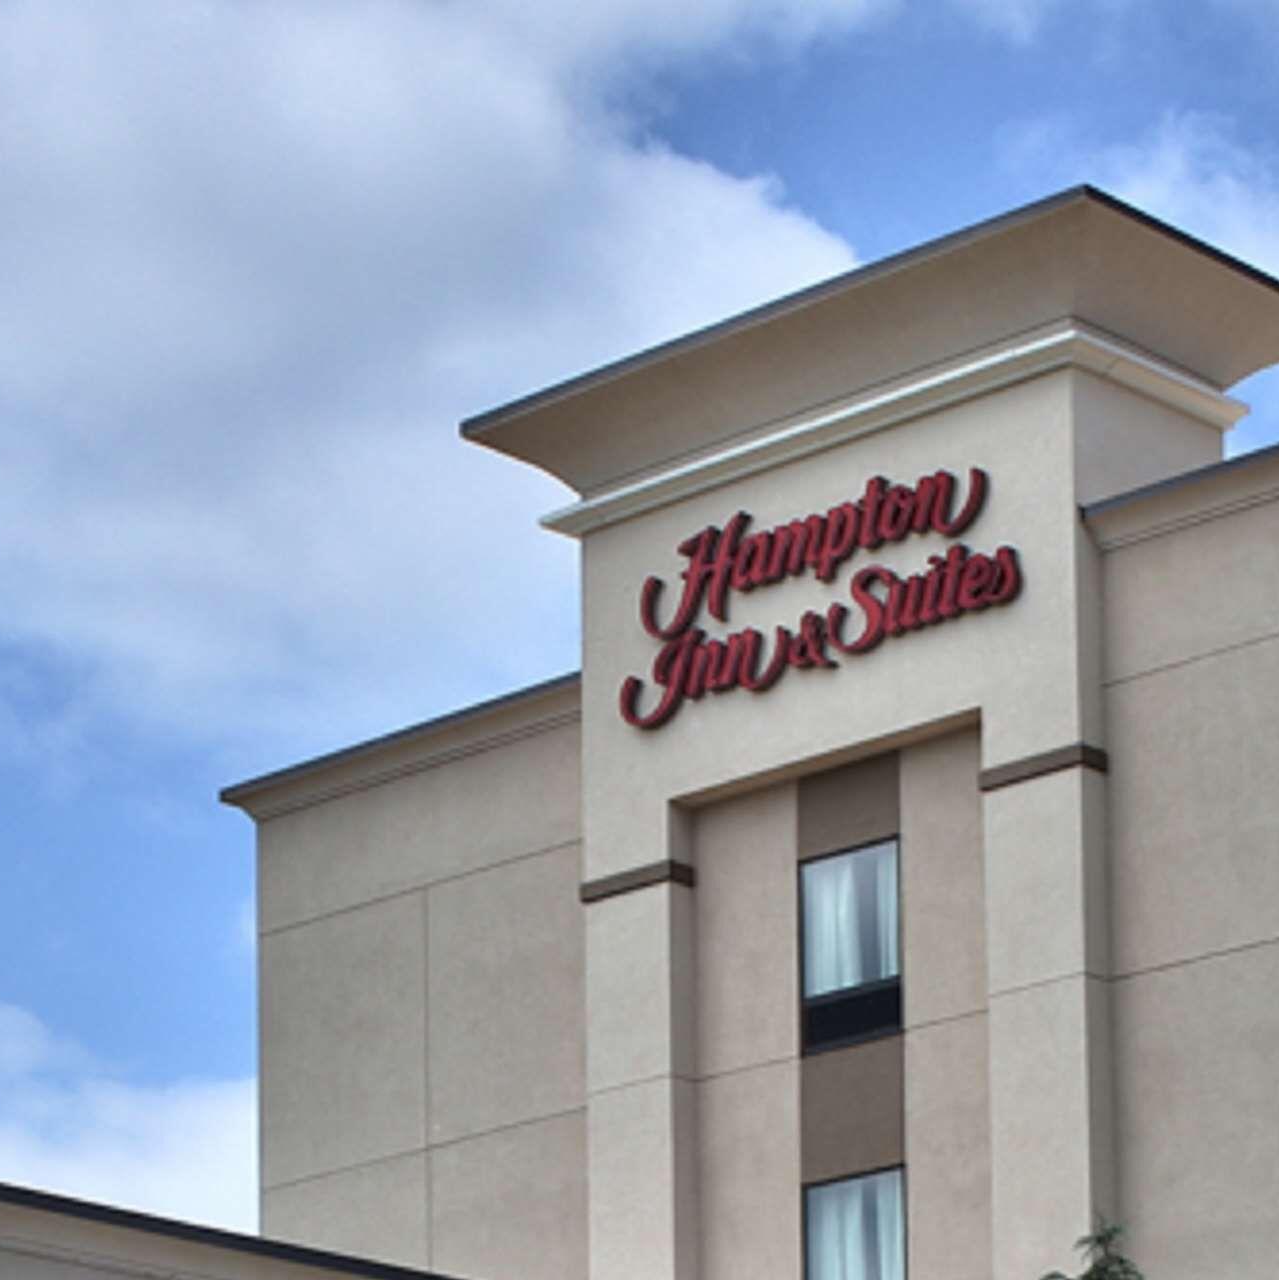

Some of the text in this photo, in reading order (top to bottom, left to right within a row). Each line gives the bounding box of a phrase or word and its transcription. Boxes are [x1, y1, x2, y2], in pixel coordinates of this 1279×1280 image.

[620, 543, 1022, 728] Inn & Suites
[640, 467, 989, 640] Hampton
